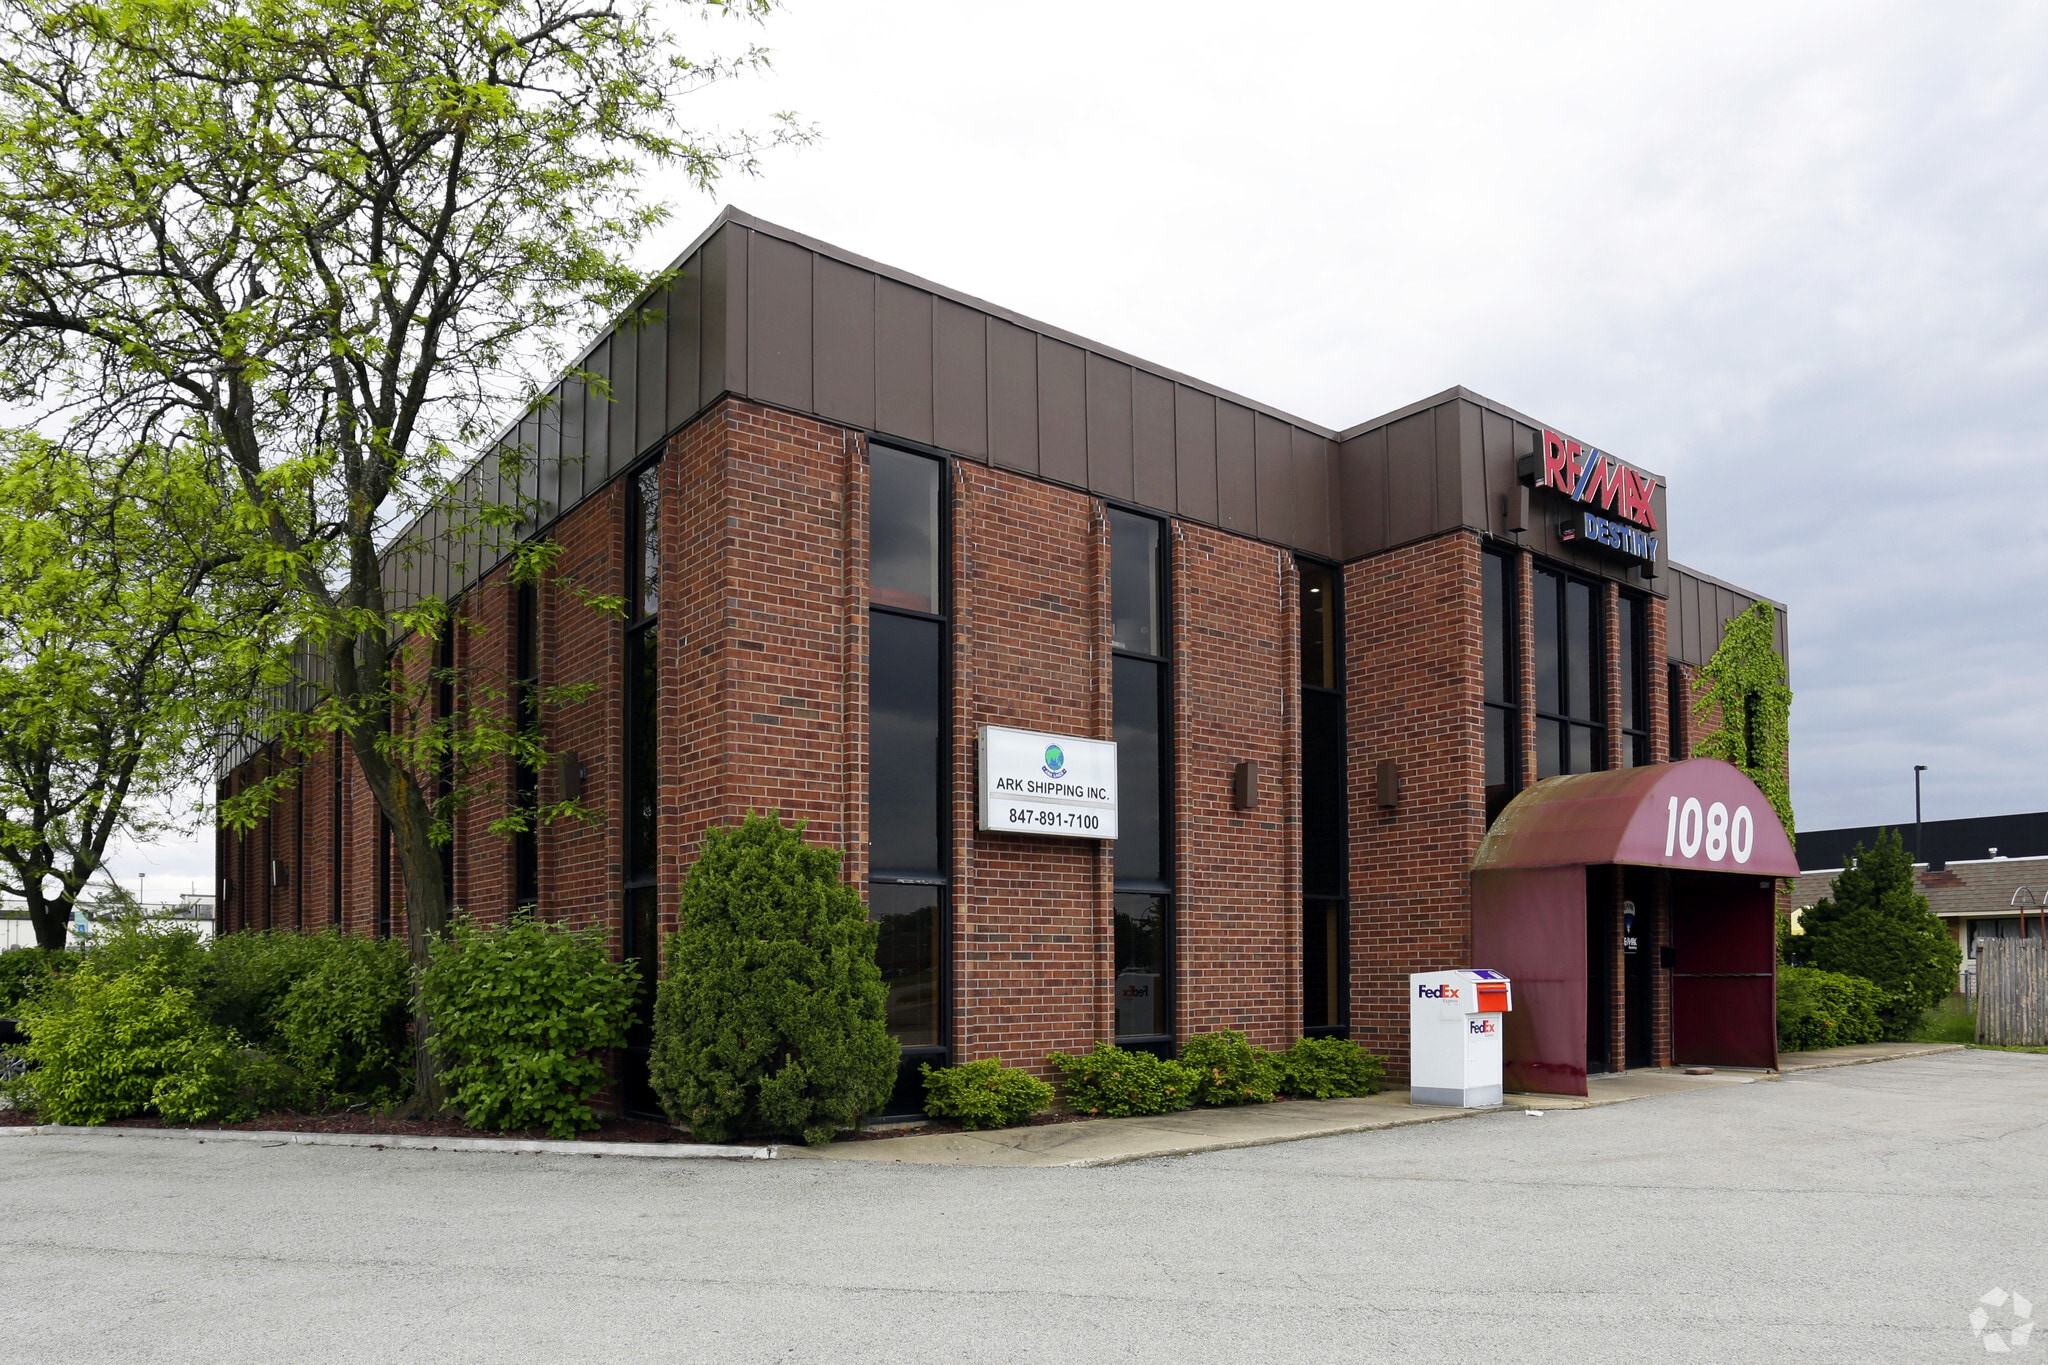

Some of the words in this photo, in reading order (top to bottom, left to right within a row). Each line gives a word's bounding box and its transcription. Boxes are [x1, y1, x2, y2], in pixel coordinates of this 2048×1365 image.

[1542, 429, 1657, 531] RE/MAX
[1584, 511, 1659, 562] DESTINY
[996, 777, 1023, 792] ARK
[1027, 780, 1084, 798] SHIPPING
[1087, 787, 1110, 801] INC.
[1009, 808, 1099, 830] 847-891-7100
[1664, 795, 1754, 864] 1080
[1418, 984, 1459, 999] FedEx
[1470, 1020, 1495, 1034] FedEx
